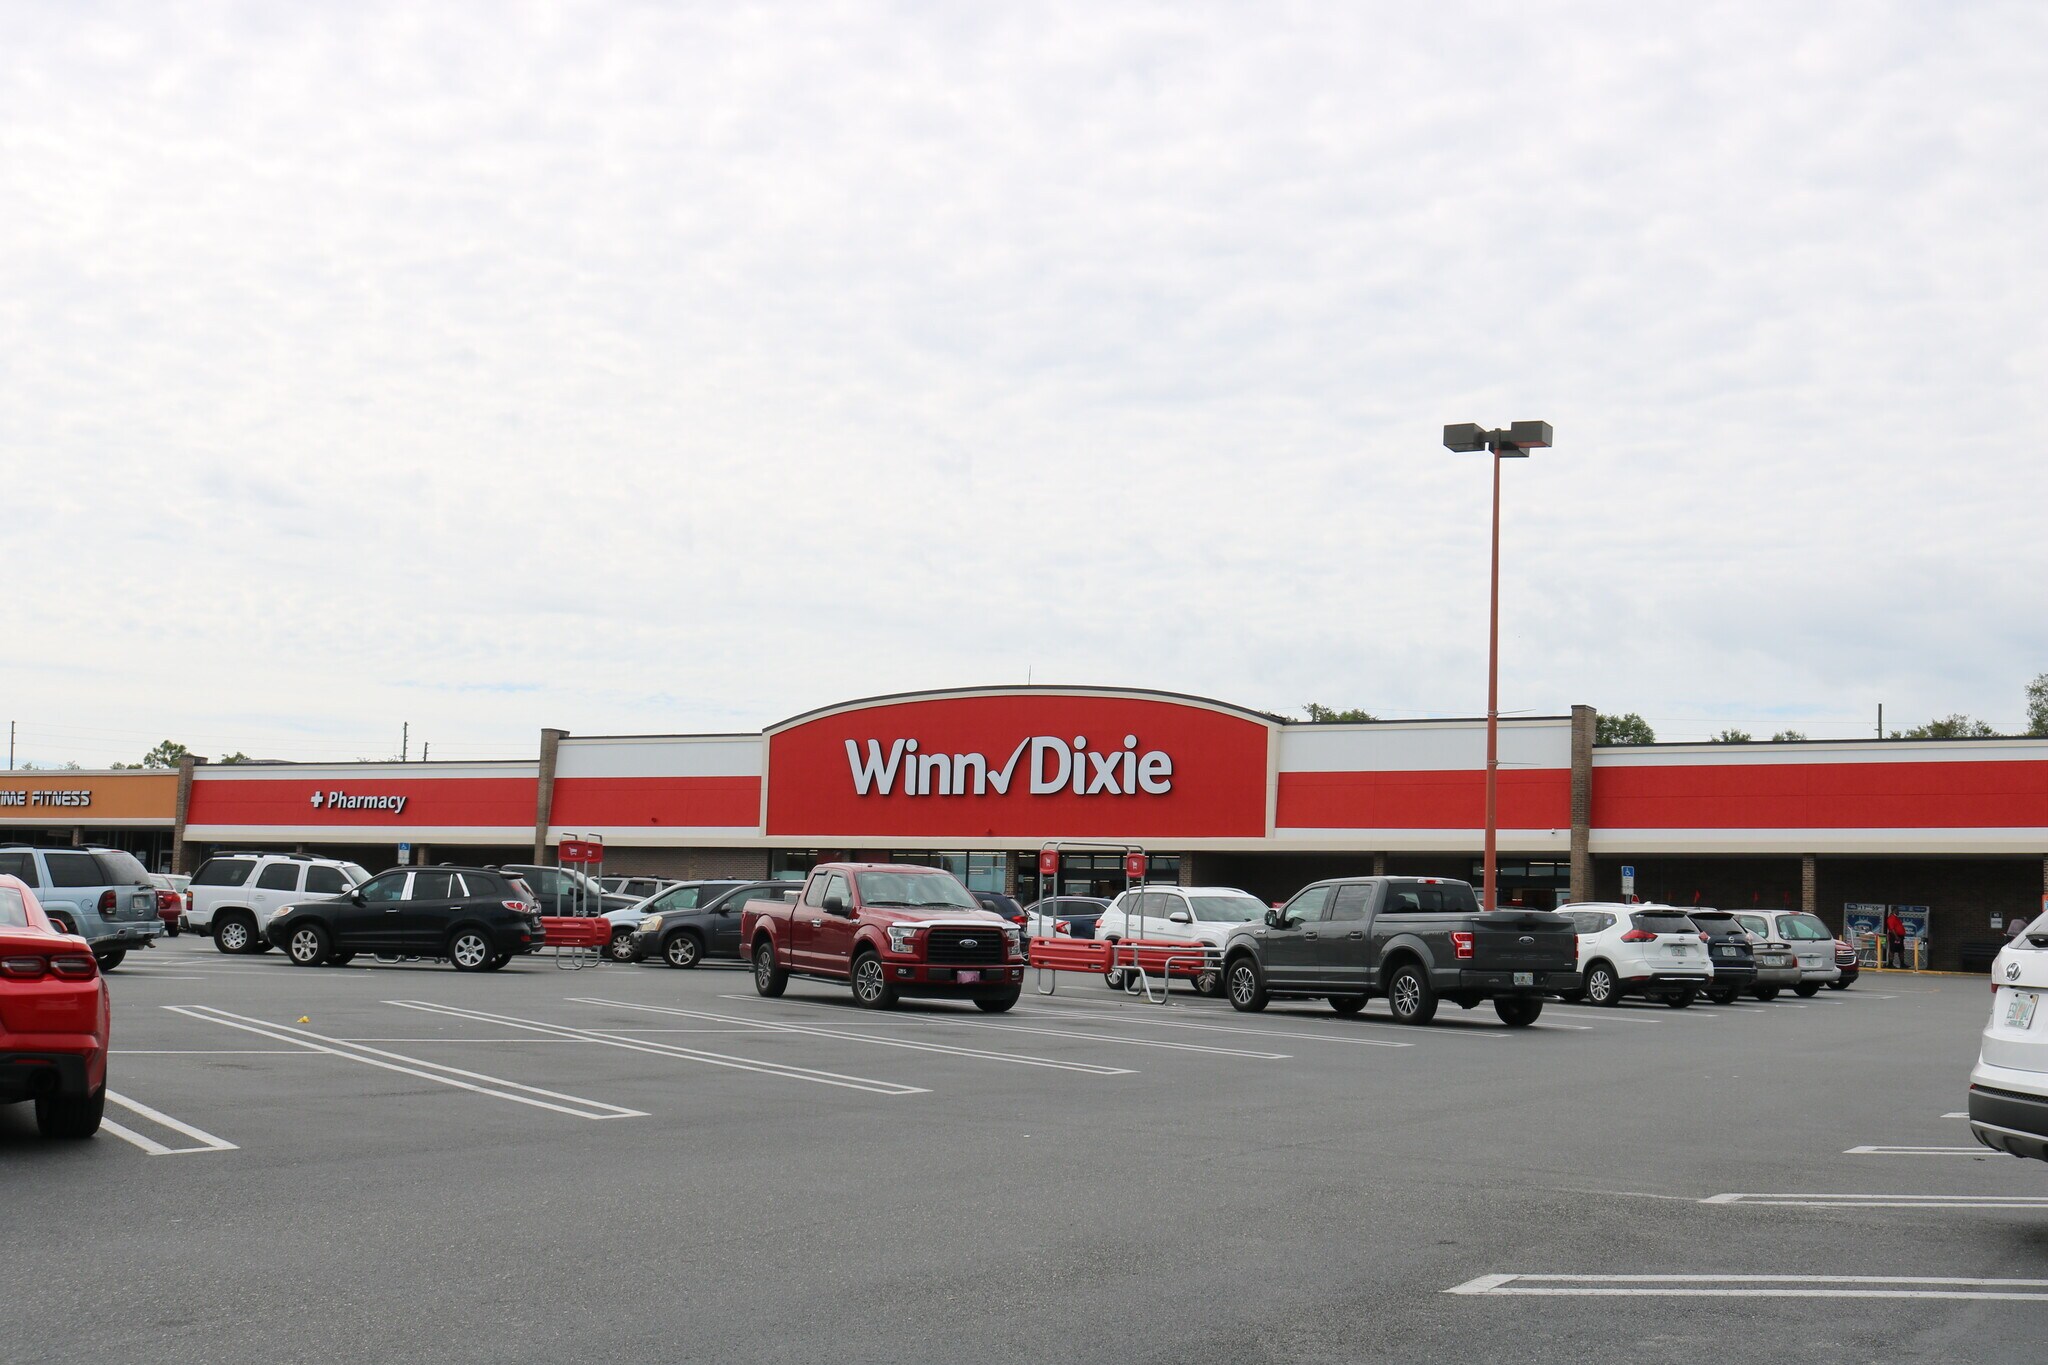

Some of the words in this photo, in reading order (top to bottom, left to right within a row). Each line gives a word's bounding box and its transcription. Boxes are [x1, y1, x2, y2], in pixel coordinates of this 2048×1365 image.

[845, 738, 986, 796] Winn
[1029, 734, 1173, 796] Dixie
[0, 790, 27, 806] IME
[31, 790, 91, 806] FITNESS
[327, 790, 407, 814] Pharmacy
